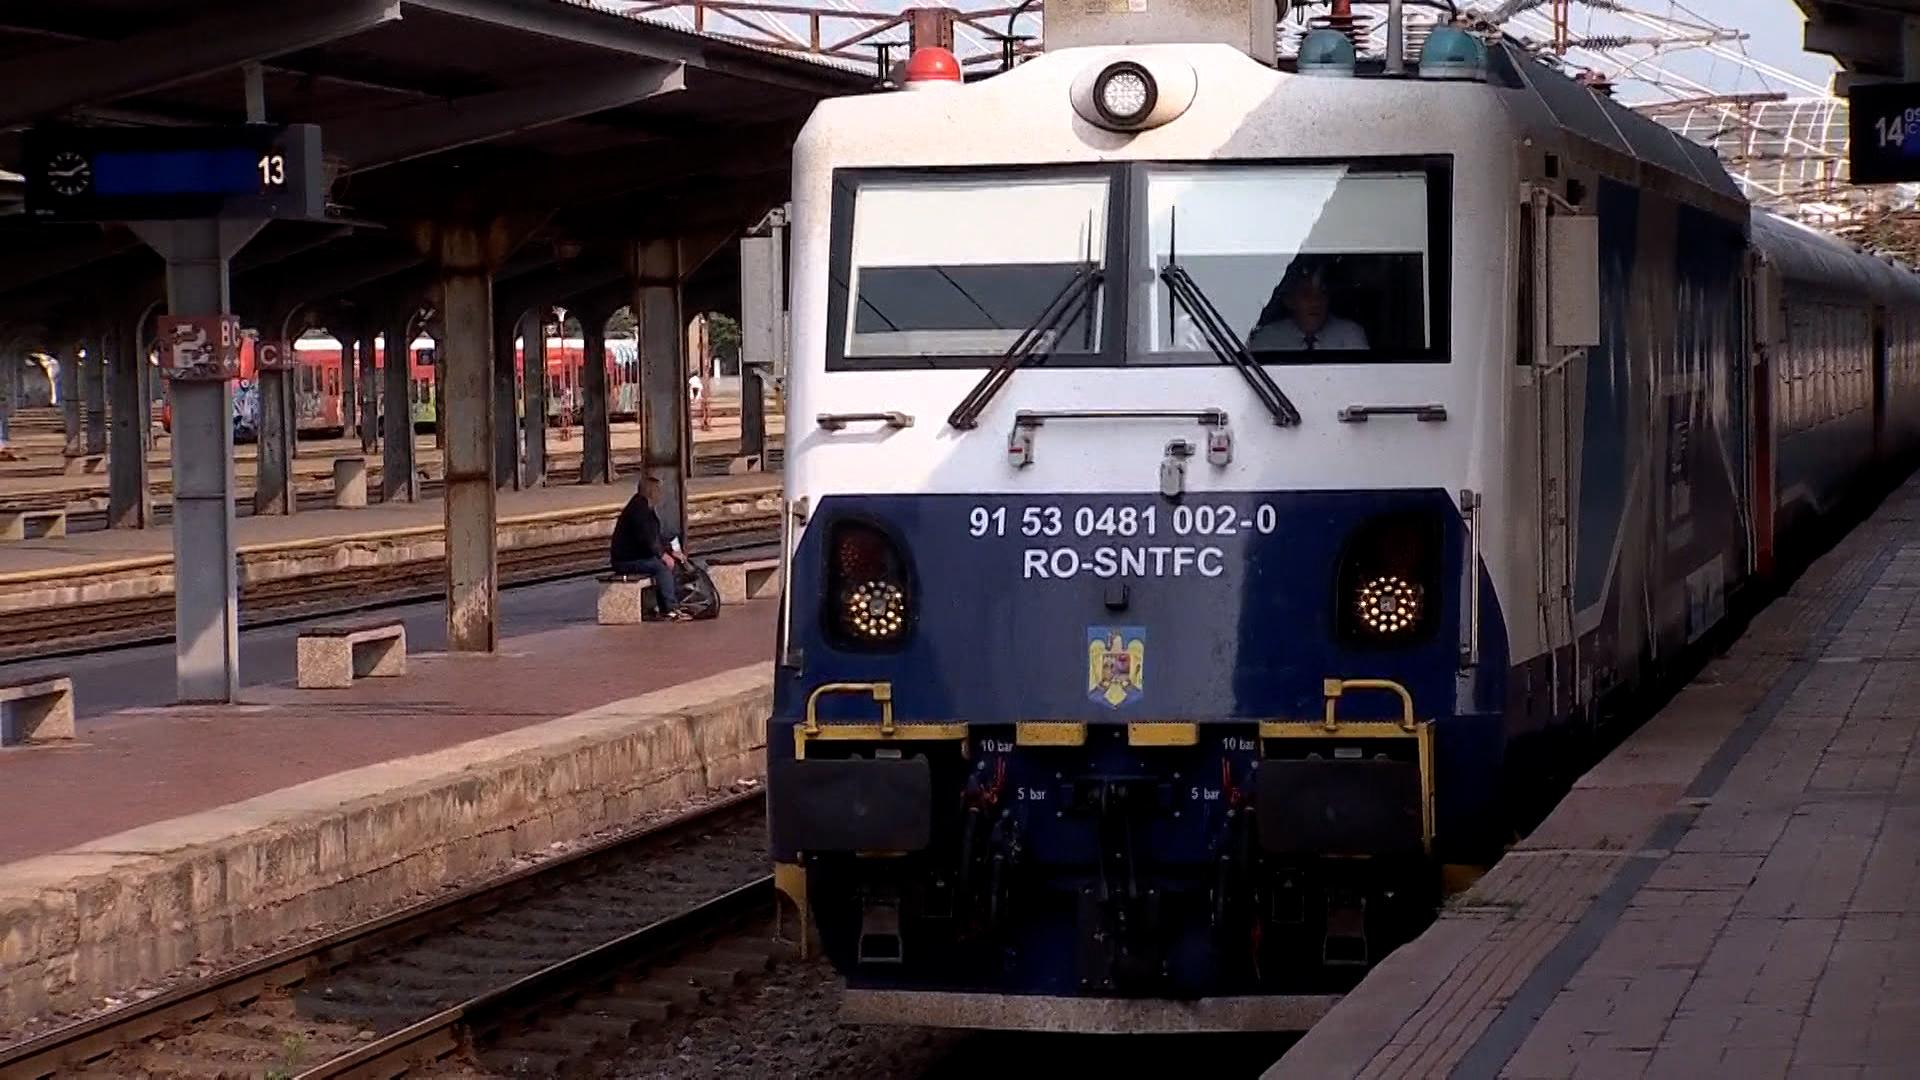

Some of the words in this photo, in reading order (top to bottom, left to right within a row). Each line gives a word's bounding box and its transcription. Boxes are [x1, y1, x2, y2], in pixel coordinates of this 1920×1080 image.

[1875, 115, 1905, 147] 14
[258, 155, 285, 185] 13
[260, 345, 277, 365] C
[969, 507, 1006, 537] 91
[1021, 507, 1062, 536] 53
[1075, 505, 1157, 536] 0481
[1172, 504, 1277, 534] 002-0
[1023, 546, 1224, 578] RO-SNTFC
[980, 739, 995, 752] 10
[997, 740, 1014, 753] bar
[1223, 737, 1237, 750] 10
[1239, 738, 1255, 751] bar
[1017, 787, 1025, 800] 5
[1029, 787, 1046, 800] bar
[1191, 787, 1199, 800] 5
[1203, 787, 1220, 800] bar
